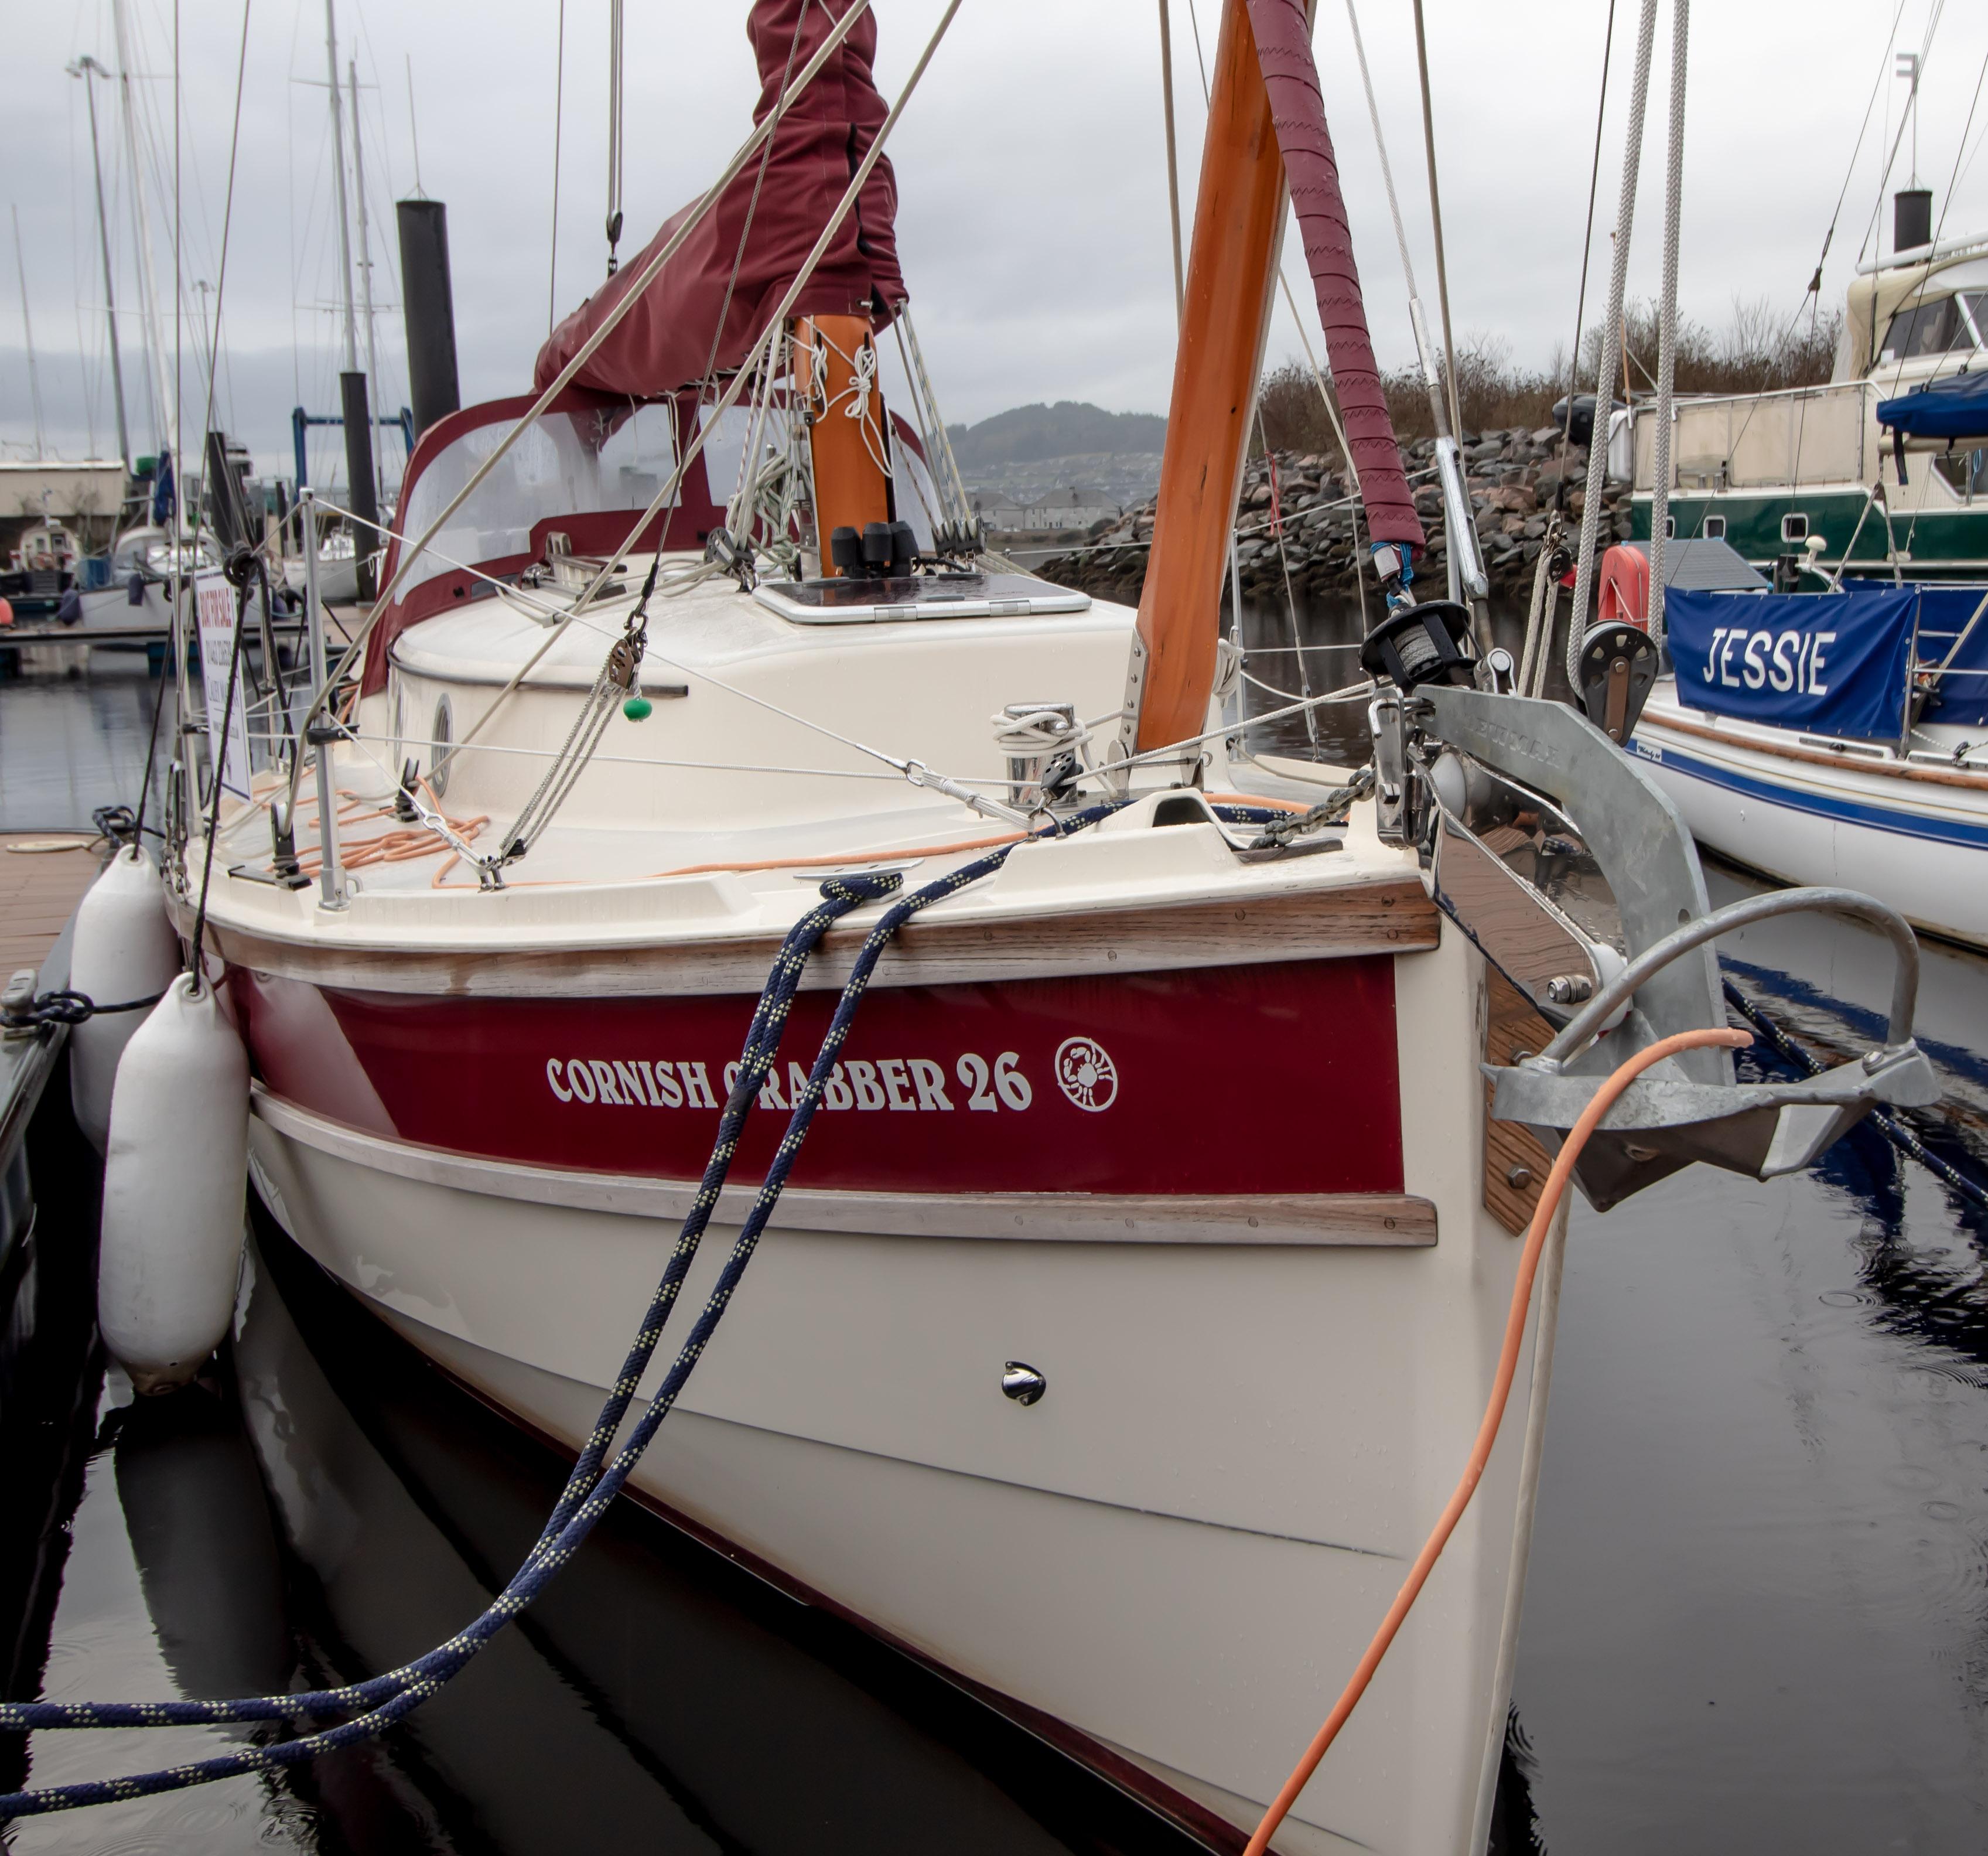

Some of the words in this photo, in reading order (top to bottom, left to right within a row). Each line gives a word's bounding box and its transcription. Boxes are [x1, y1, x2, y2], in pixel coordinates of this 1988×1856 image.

[1703, 627, 1836, 695] JESSIE
[546, 1058, 719, 1108] CORNISH
[956, 1052, 1033, 1112] 26
